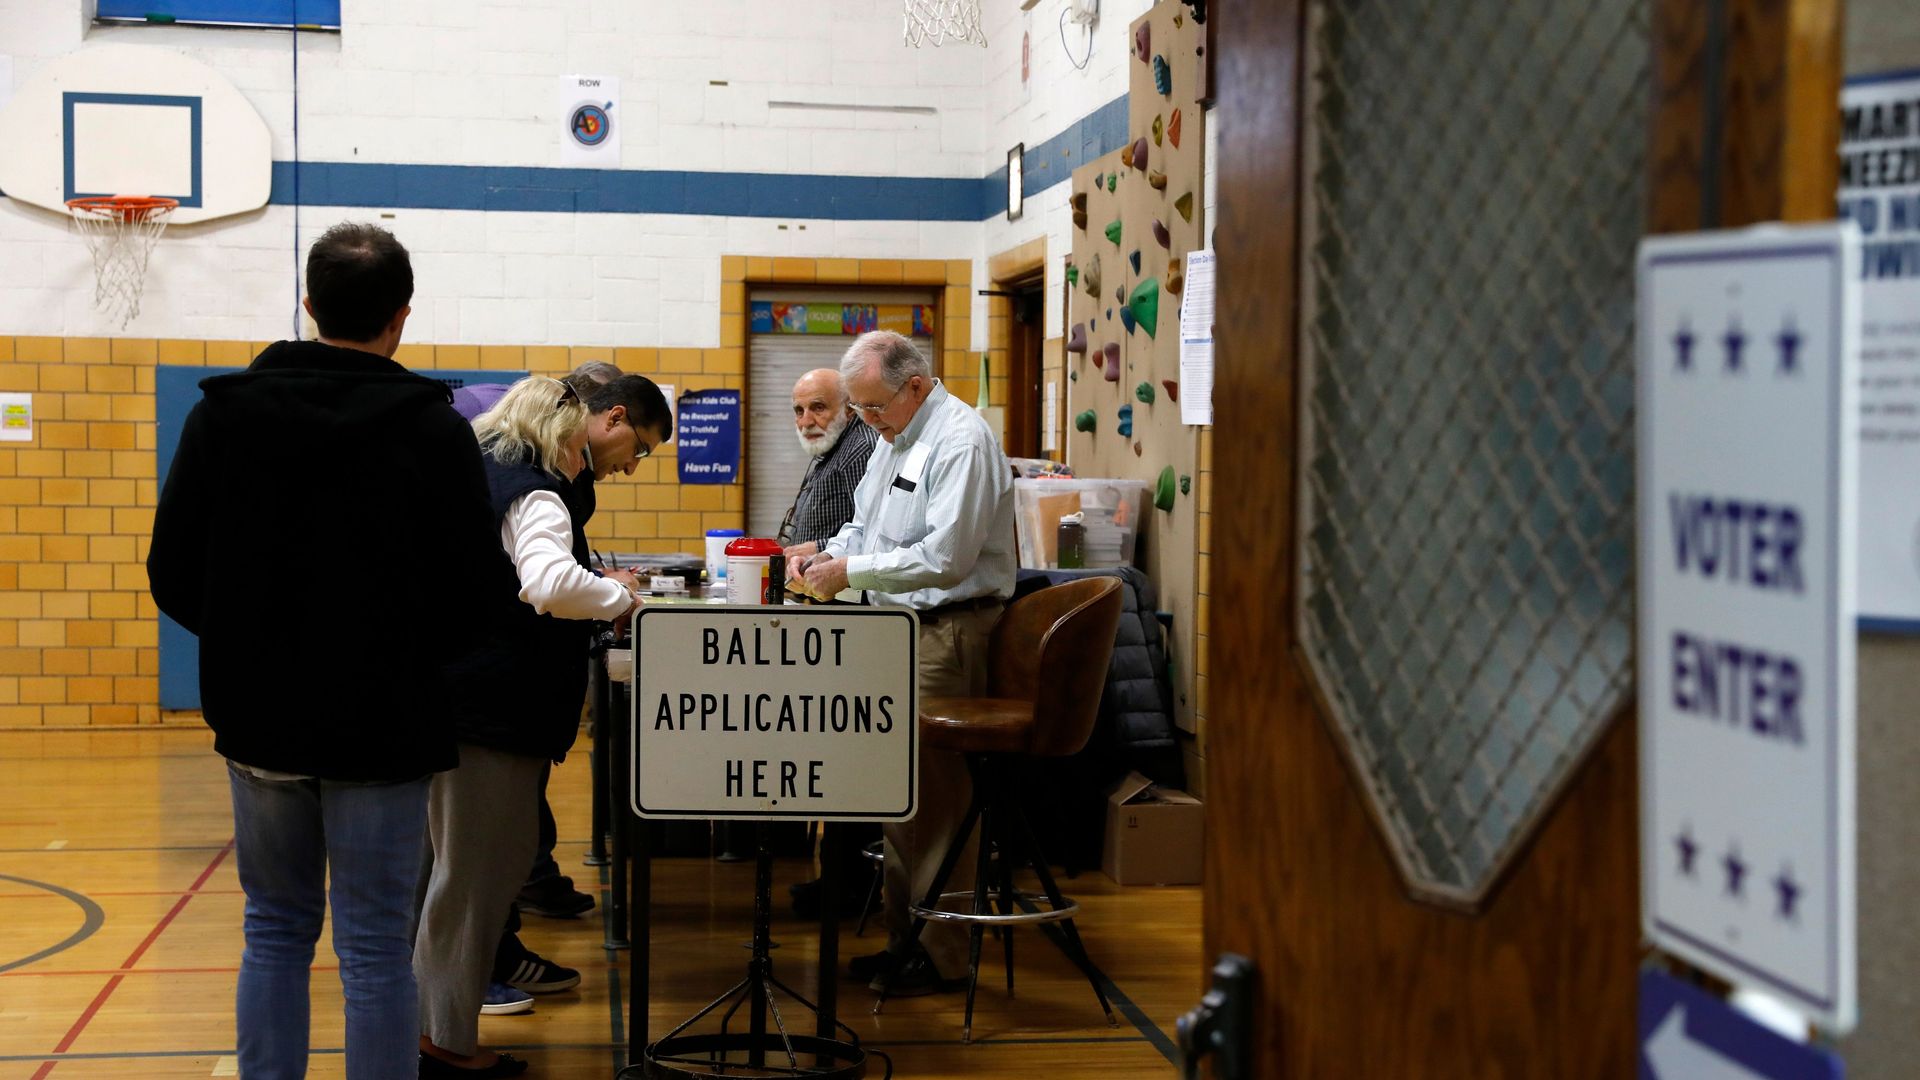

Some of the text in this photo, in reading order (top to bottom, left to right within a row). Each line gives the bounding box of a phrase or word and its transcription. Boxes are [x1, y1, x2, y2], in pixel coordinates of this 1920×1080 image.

[578, 79, 601, 88] ROW
[702, 396, 718, 405] Kids
[720, 395, 737, 405] Club
[680, 412, 729, 422] Be Respectful
[679, 425, 719, 433] Be Truthful
[679, 438, 708, 447] Be Kind
[685, 462, 731, 473] Have Fun
[1668, 493, 1805, 596] VOTER
[702, 627, 846, 666] BALLOT
[1672, 631, 1805, 747] ENTER
[654, 693, 894, 734] APPLICATIONS
[726, 760, 824, 798] HERE
